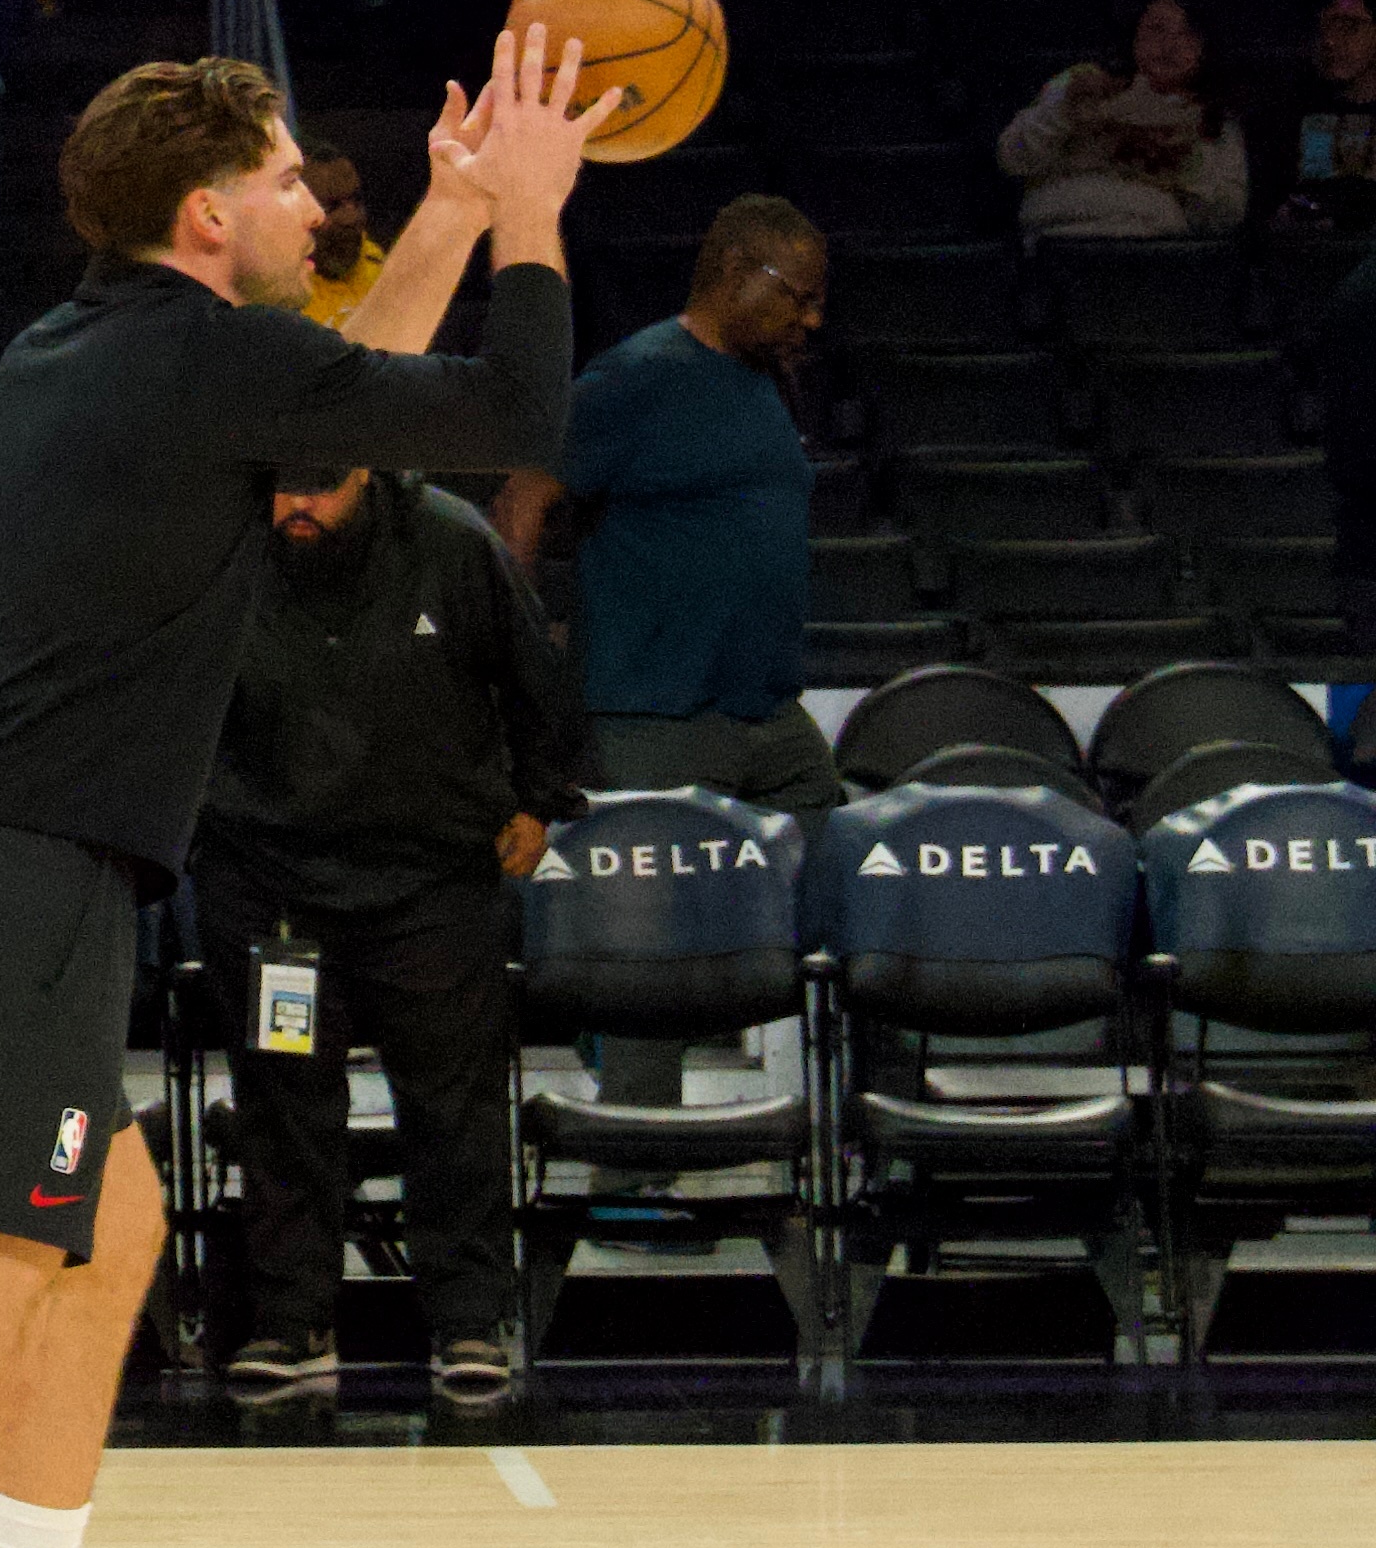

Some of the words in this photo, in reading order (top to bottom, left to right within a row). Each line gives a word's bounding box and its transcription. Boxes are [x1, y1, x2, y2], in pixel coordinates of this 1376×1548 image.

[590, 839, 767, 877] DELTA
[918, 843, 1098, 877] DELTA
[1247, 837, 1376, 872] DELT
